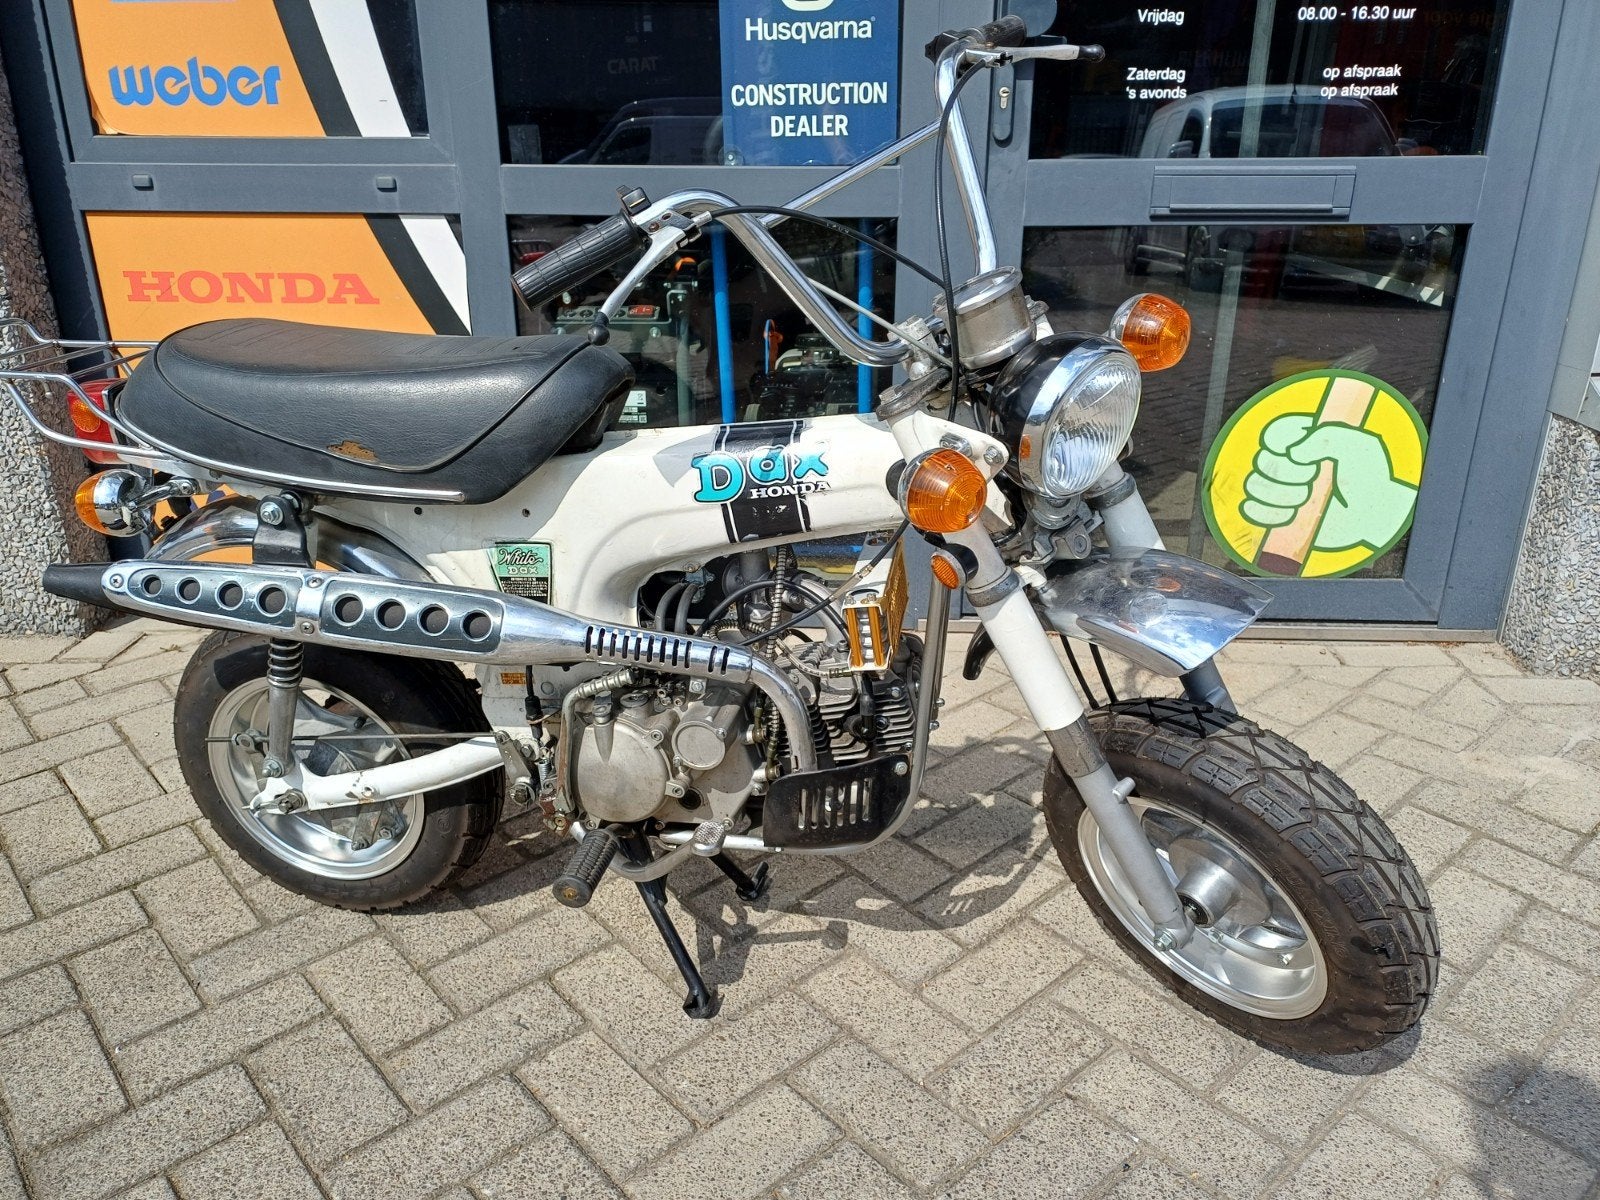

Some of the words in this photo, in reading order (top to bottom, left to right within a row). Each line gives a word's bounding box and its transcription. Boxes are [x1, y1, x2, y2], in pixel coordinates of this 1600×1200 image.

[1138, 9, 1185, 26] Vrijdag
[1298, 6, 1338, 21] 08.00
[1351, 5, 1389, 20] 16.30
[1393, 7, 1417, 19] uur
[745, 17, 872, 44] Husqvarna
[607, 55, 659, 75] CARAT
[1127, 66, 1186, 83] Zaterdag
[1323, 67, 1340, 81] op
[1343, 64, 1402, 80] afspraak
[108, 56, 281, 106] weber
[1139, 85, 1187, 99] avonds
[1320, 86, 1337, 100] op
[1340, 83, 1399, 99] afspraak
[731, 81, 888, 106] CONSTRUCTION
[770, 114, 849, 138] DEALER
[122, 270, 380, 304] HONDA
[691, 443, 830, 504] Dax
[749, 480, 832, 499] HONDA
[498, 547, 544, 566] White
